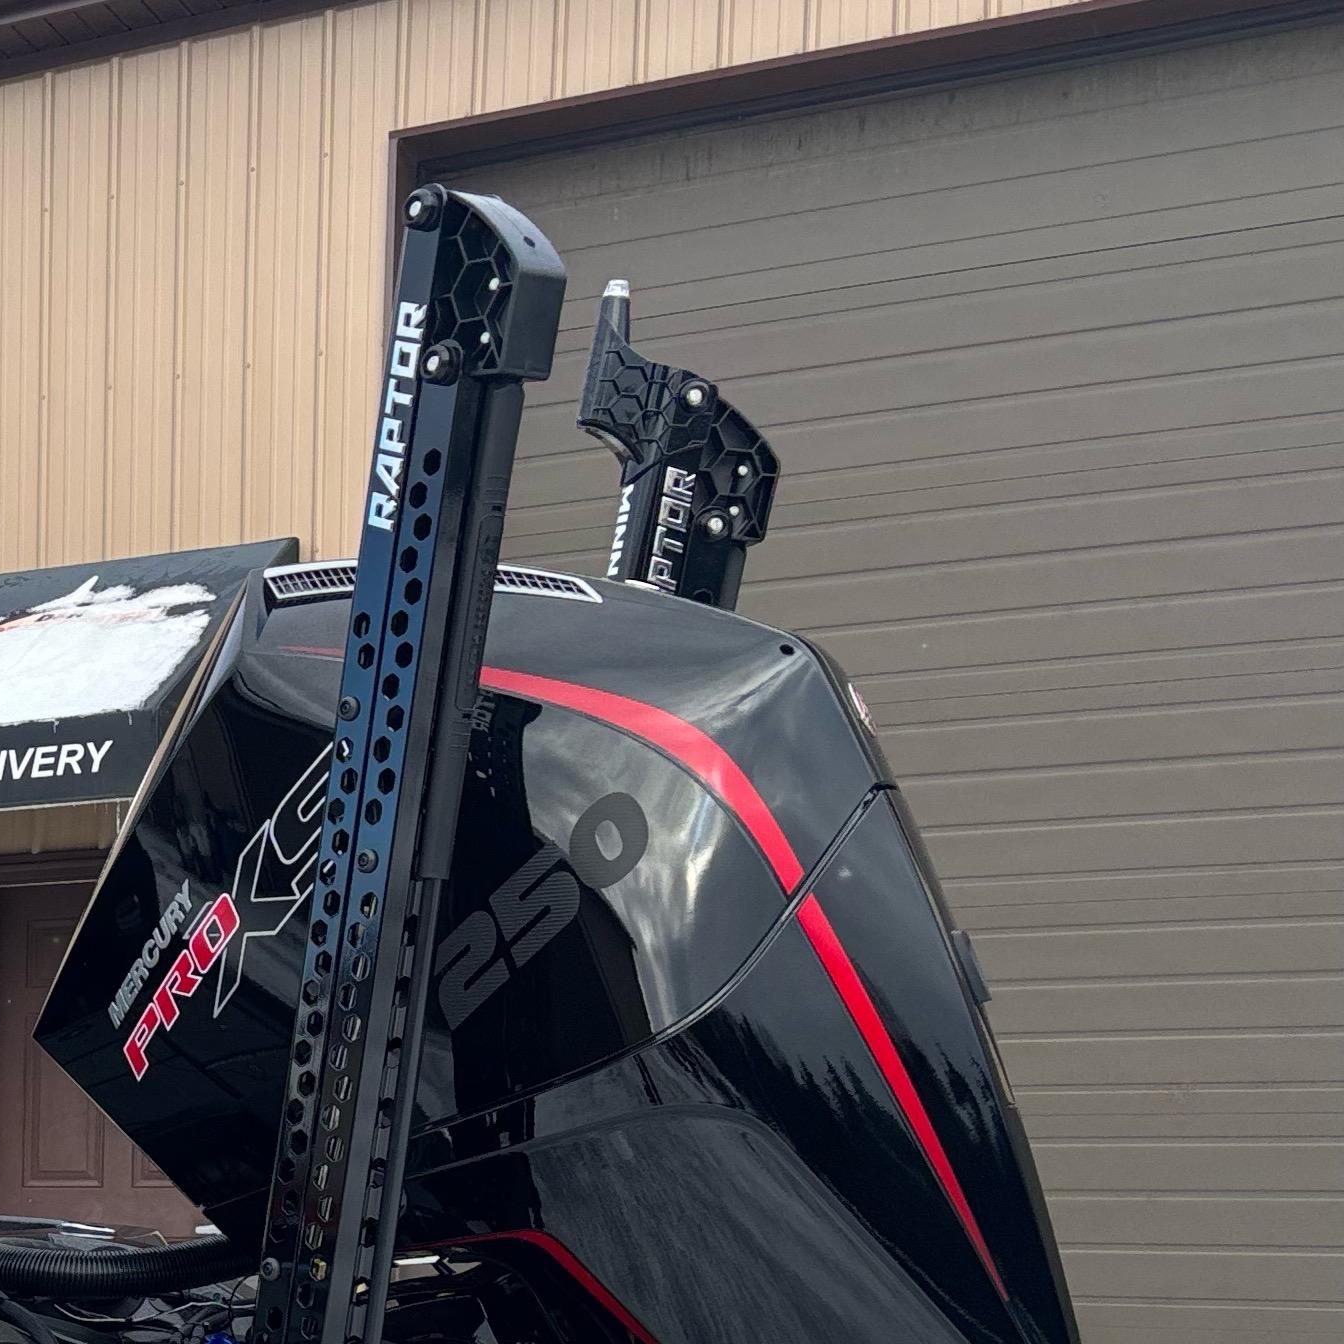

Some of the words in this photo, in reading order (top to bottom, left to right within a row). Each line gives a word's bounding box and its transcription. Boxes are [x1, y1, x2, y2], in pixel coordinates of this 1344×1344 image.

[368, 301, 428, 531] RAPTOR
[606, 483, 635, 577] MINN
[647, 465, 697, 592] PTOR
[107, 877, 193, 1031] MERCURY
[122, 892, 241, 1083] PRO
[433, 791, 650, 1032] 250
